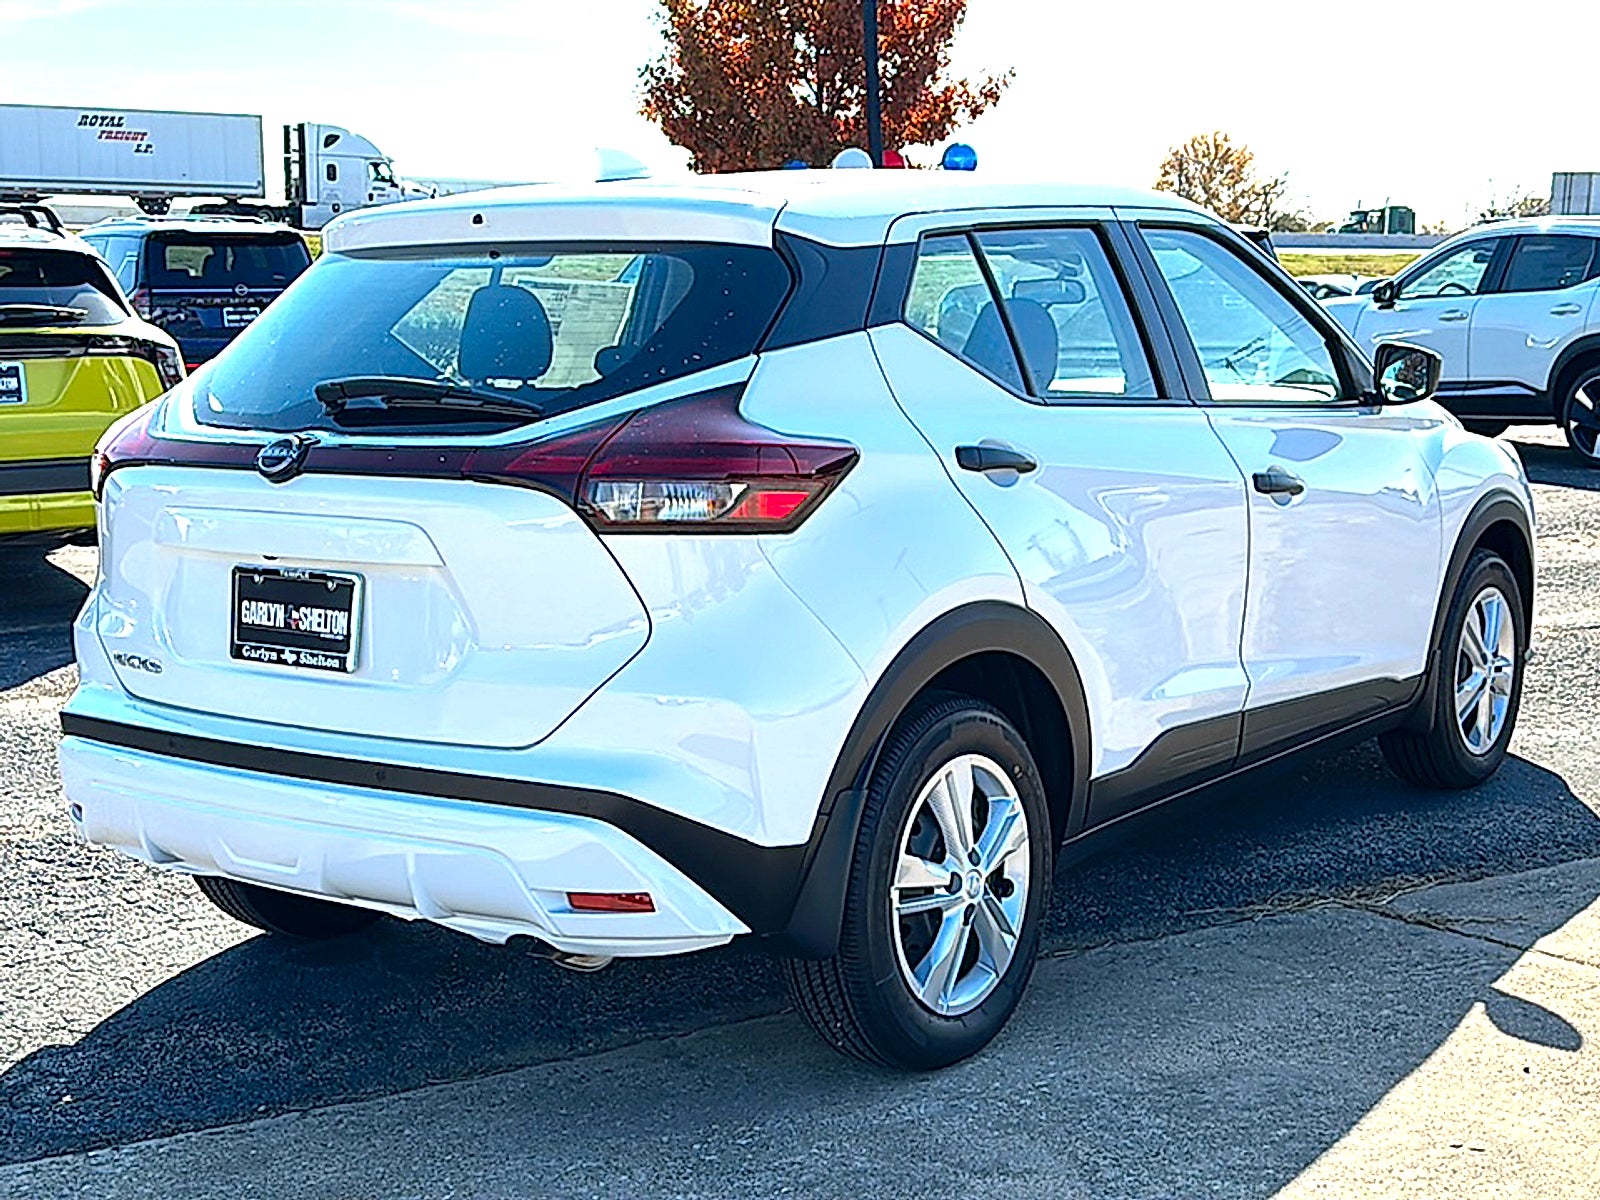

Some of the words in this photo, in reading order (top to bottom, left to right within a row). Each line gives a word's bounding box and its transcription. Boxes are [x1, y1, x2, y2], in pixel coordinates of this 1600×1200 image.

[77, 114, 125, 128] ROYAL
[97, 129, 148, 142] FREIGHT
[241, 599, 285, 628] GARLYN
[299, 606, 349, 637] SHELTON
[241, 645, 278, 662] Garlyn
[298, 651, 340, 669] Shelton
